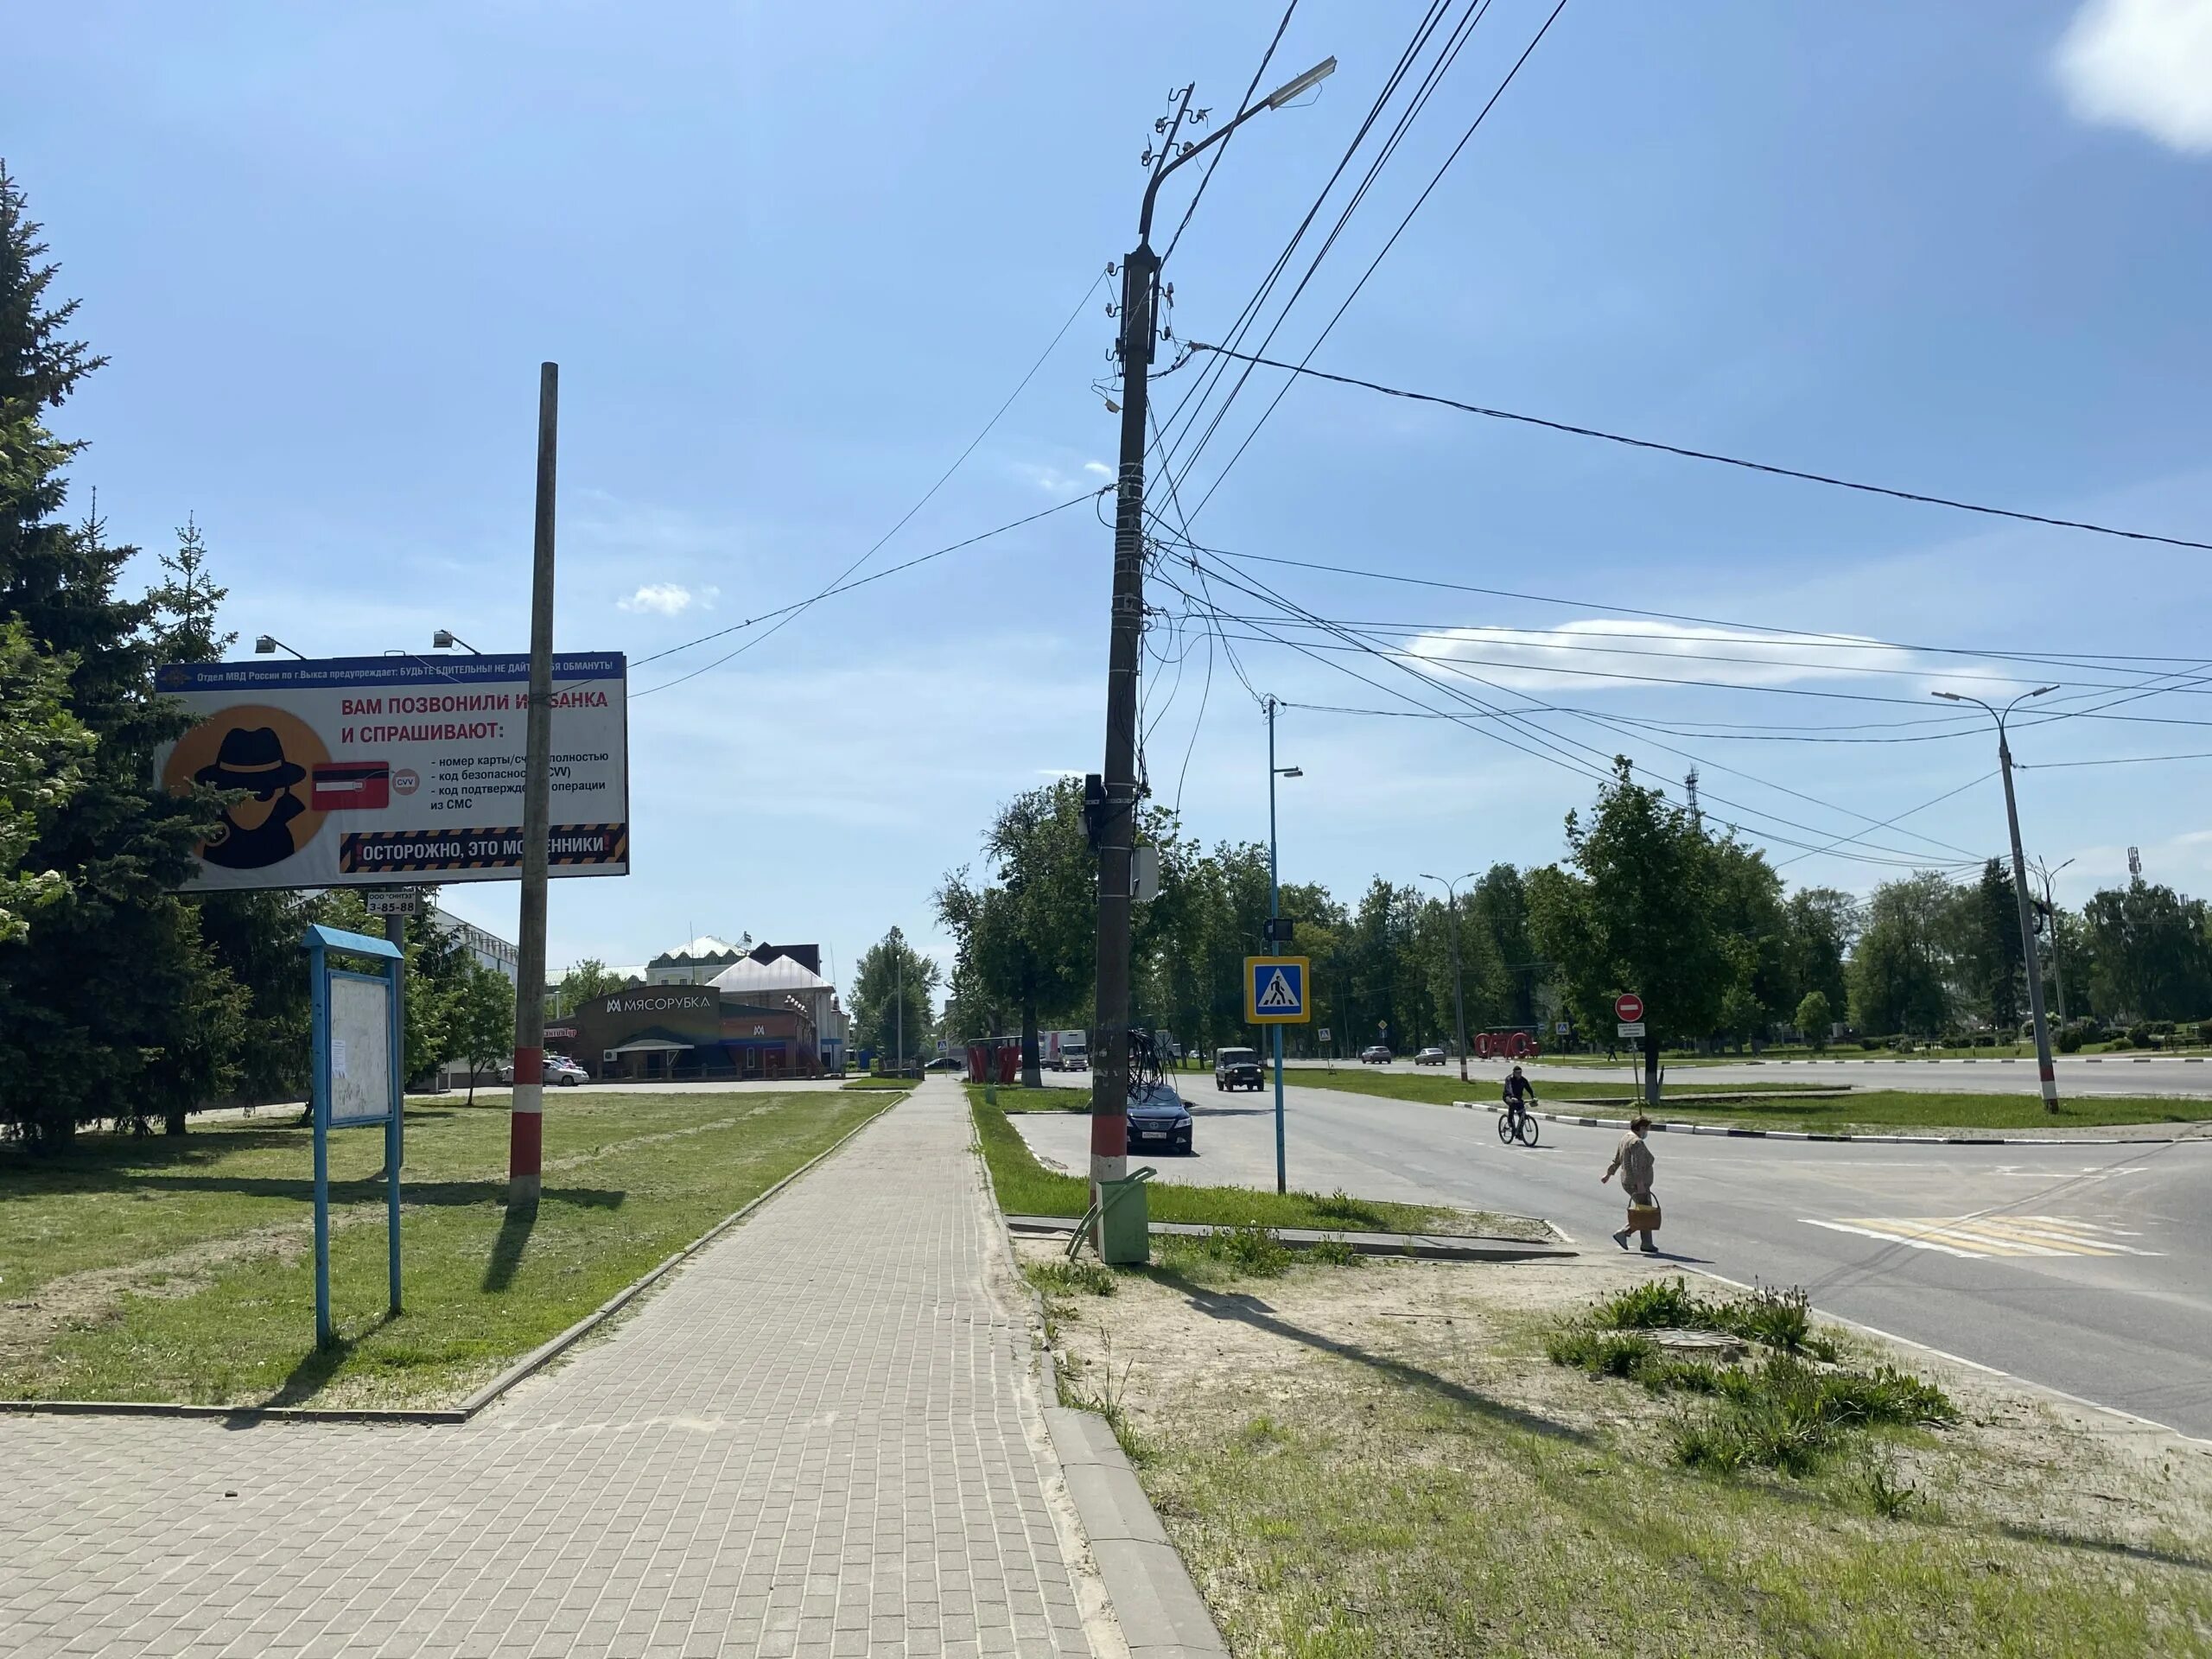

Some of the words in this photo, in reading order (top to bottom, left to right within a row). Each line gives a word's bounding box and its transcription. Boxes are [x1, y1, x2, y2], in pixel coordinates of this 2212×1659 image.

[197, 672, 224, 683] Отдел
[226, 671, 247, 682] МВД
[249, 671, 280, 681] России
[329, 668, 398, 679] предупреждает:
[400, 666, 434, 677] БУДЬТЕ
[435, 664, 493, 676] БДИТЕЛЬНЫ!
[494, 664, 506, 673] НЕ
[508, 661, 531, 674] ДАЙТ
[563, 661, 613, 671] ОБМАНУТЬ!
[341, 698, 382, 715] ВАМ
[388, 693, 510, 714] ПОЗВОНИЛИ
[515, 693, 528, 709] И
[341, 727, 354, 743] И
[359, 721, 504, 742] СПРАШИВАЮТ:
[439, 757, 475, 767] номер
[477, 754, 527, 767] карты/сч
[550, 751, 609, 763] полностью
[439, 772, 459, 782] код
[461, 768, 526, 780] безопаснос
[439, 786, 459, 797] код
[461, 784, 526, 796] подтвержде
[551, 780, 607, 793] операции
[430, 801, 443, 810] из
[446, 798, 473, 810] СМС
[468, 840, 498, 856] ЭТО
[369, 902, 415, 912] 3-85-88
[624, 996, 710, 1011] МЯСОРУБКА
